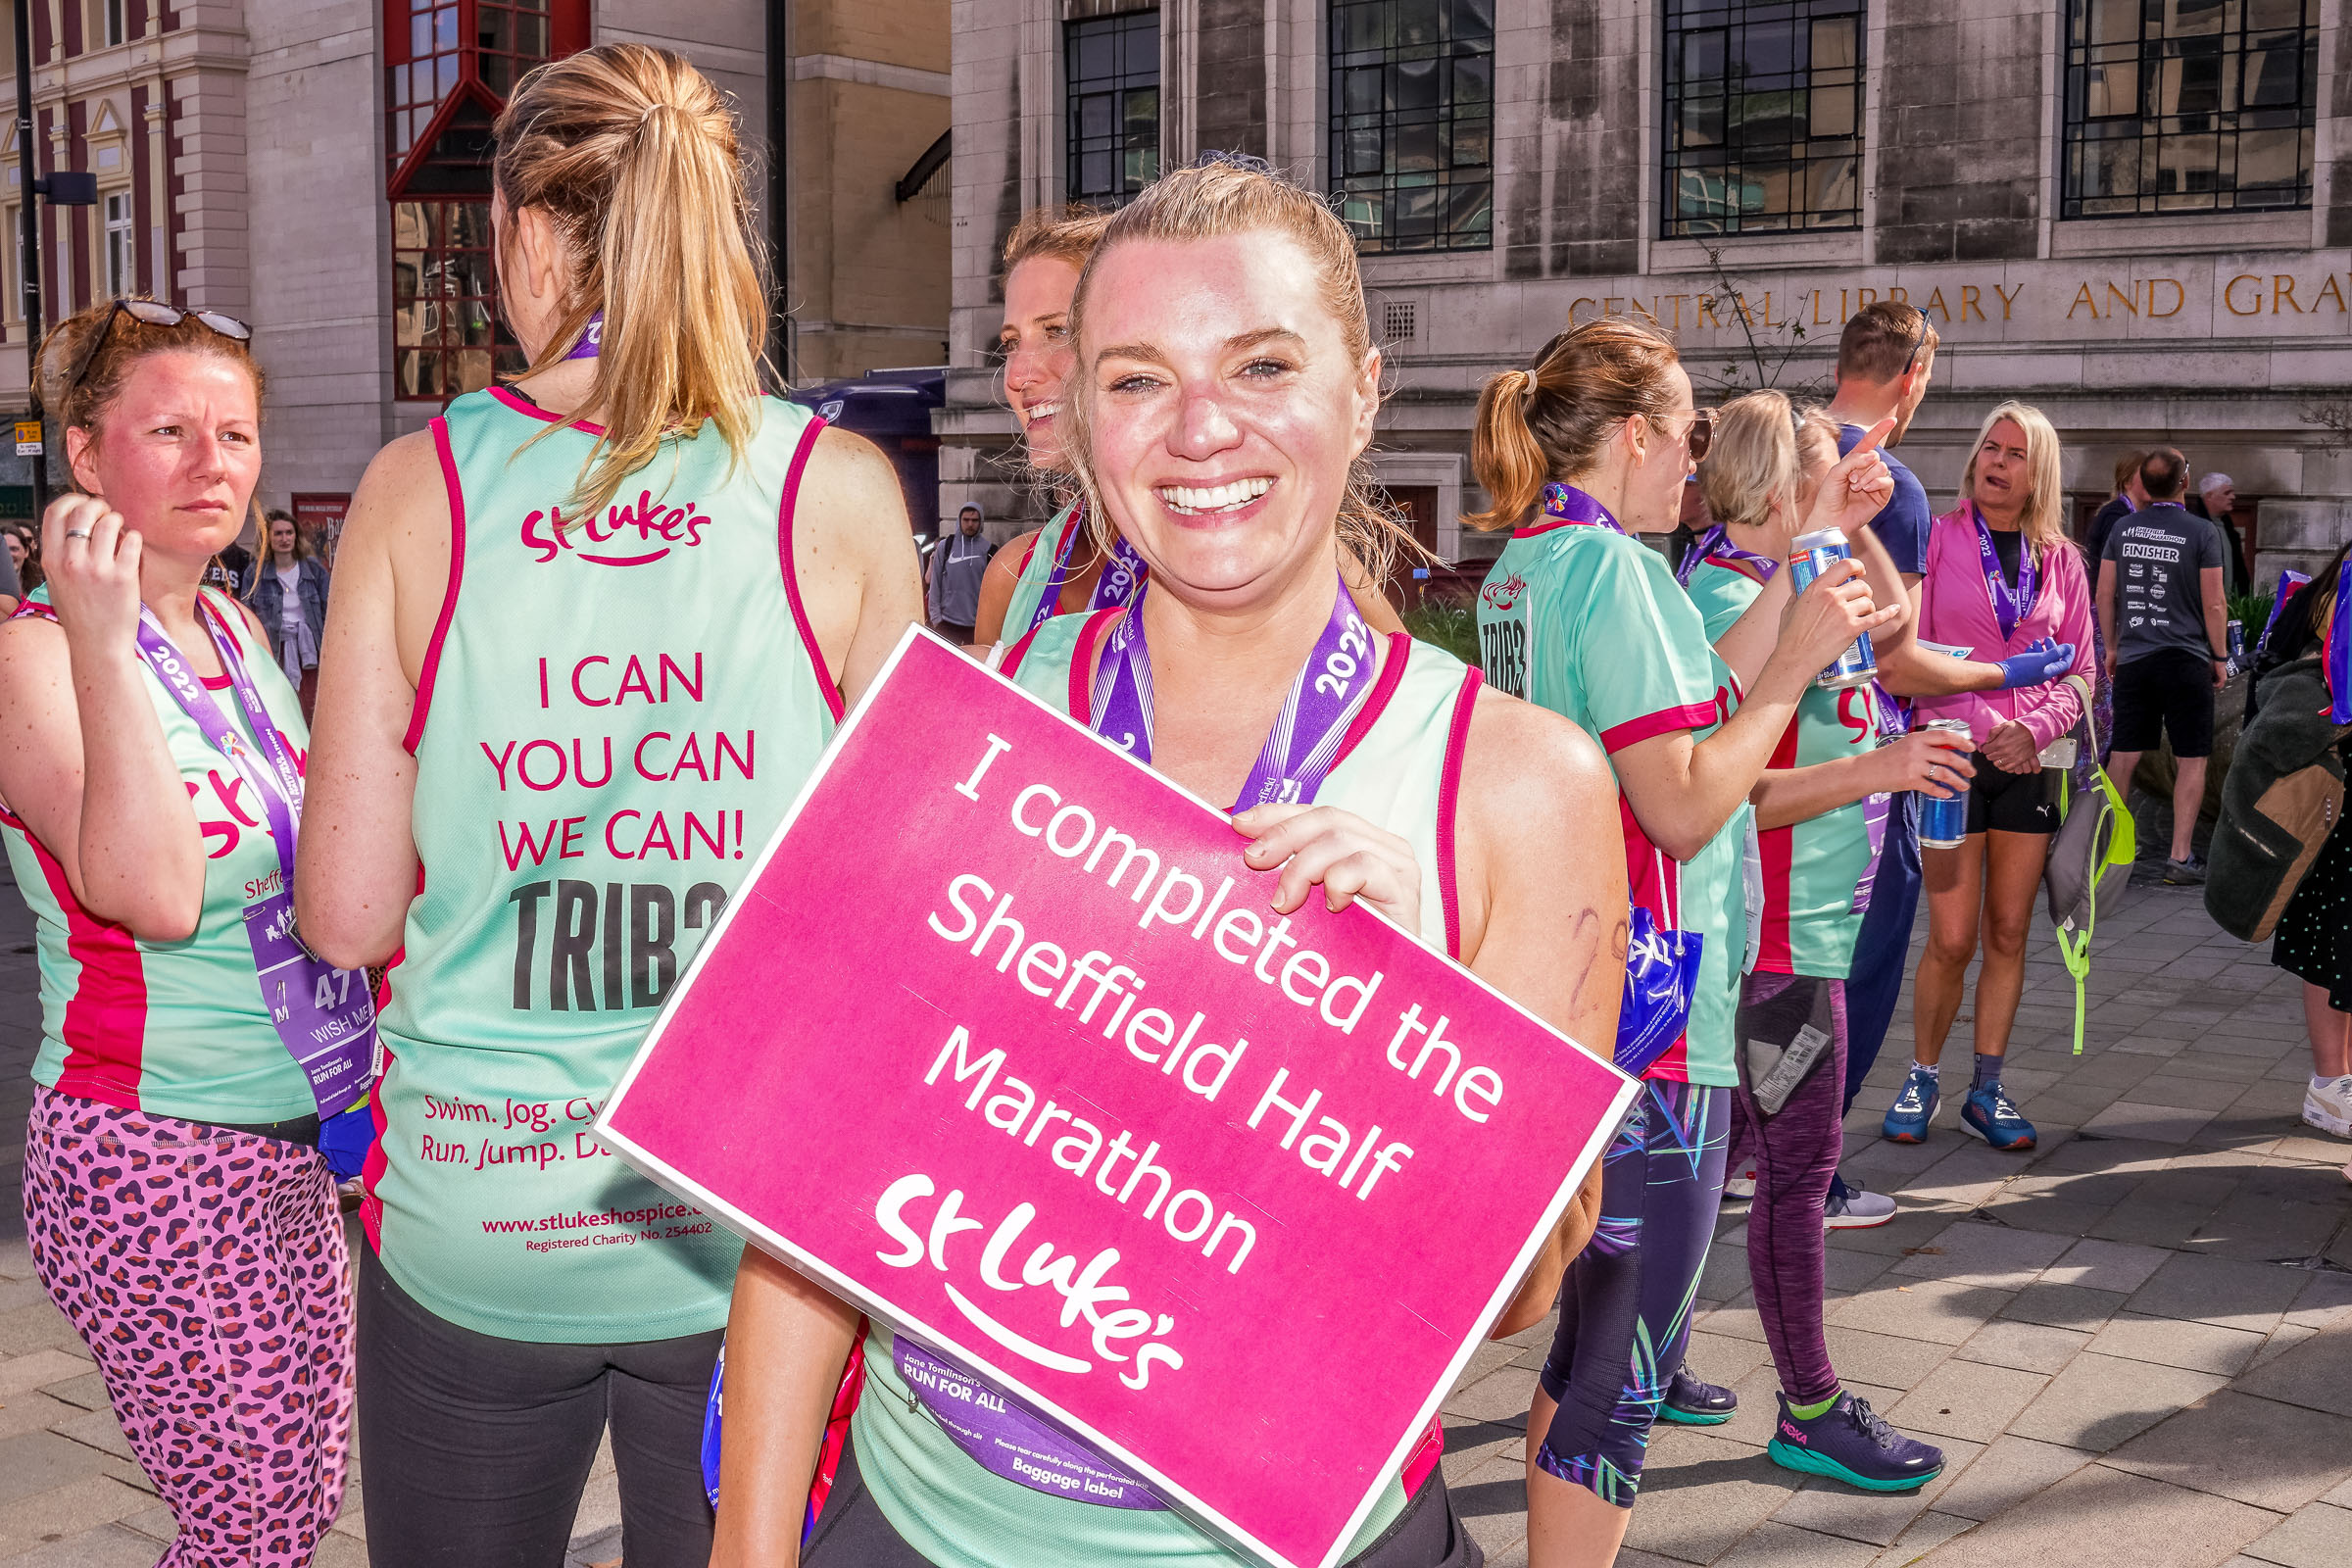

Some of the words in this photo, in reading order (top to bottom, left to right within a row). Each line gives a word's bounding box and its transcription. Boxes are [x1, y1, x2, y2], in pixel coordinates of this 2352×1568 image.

[2067, 277, 2185, 320] AND
[2224, 272, 2352, 317] GRA
[1979, 534, 1992, 557] 2022
[2123, 543, 2180, 563] FINISHER
[150, 646, 199, 703] 2022
[538, 657, 550, 709] I
[570, 652, 704, 708] CAN
[1314, 612, 1368, 701] 2022
[1483, 618, 1527, 700] TRIB3
[480, 736, 613, 792] YOU
[634, 729, 756, 783] CAN
[498, 814, 588, 871] WE
[605, 809, 745, 861] CAN!
[954, 732, 1012, 802] I
[1010, 780, 1385, 1037] completed
[1385, 1002, 1504, 1125] the
[310, 1014, 353, 1044] WISH
[927, 872, 1249, 1103] Sheffield
[1248, 1066, 1414, 1201] Half
[313, 1069, 330, 1085] RUN
[329, 1063, 342, 1078] FOR
[343, 1058, 353, 1071] ALL
[424, 1095, 497, 1123] Swim.
[504, 1098, 556, 1133] Jog.
[565, 1097, 606, 1126] Cy
[421, 1134, 469, 1165] Run.
[474, 1138, 565, 1171] Jump.
[923, 1023, 1258, 1278] Marathon
[525, 1235, 590, 1252] Registered
[592, 1232, 638, 1250] Charity
[641, 1229, 662, 1242] No.
[665, 1221, 713, 1240] 254402
[875, 1173, 984, 1269] St
[978, 1200, 1184, 1392] Luke's
[904, 1353, 926, 1368] Jane
[928, 1362, 981, 1388] Tomlinson's
[904, 1363, 937, 1390] RUN
[939, 1379, 973, 1403] FOR
[975, 1394, 1006, 1414] ALL
[948, 1420, 972, 1437] through
[973, 1432, 983, 1441] slit
[1781, 1420, 1807, 1445] HOKA
[995, 1438, 1017, 1451] Please
[1017, 1446, 1032, 1455] tear
[1032, 1449, 1062, 1466] carefully
[1062, 1460, 1083, 1473] along
[1084, 1467, 1096, 1476] the
[1096, 1471, 1135, 1486] perforated
[1012, 1457, 1081, 1491] Baggage
[1084, 1478, 1124, 1499] label
